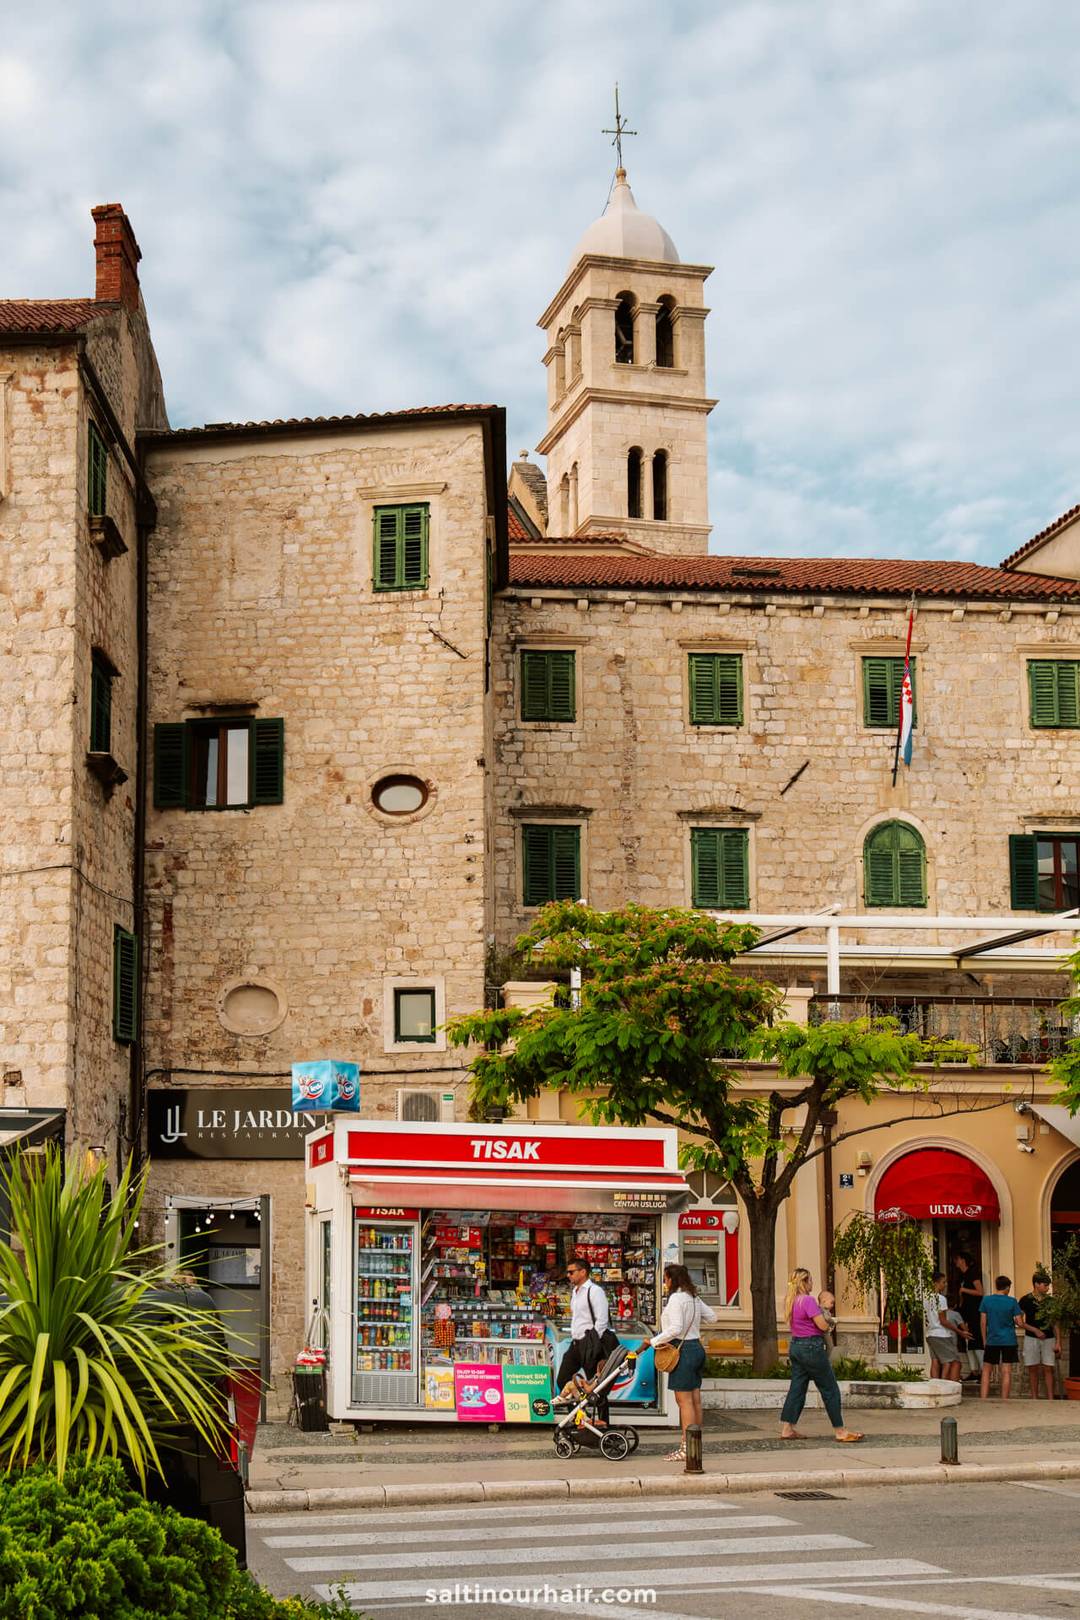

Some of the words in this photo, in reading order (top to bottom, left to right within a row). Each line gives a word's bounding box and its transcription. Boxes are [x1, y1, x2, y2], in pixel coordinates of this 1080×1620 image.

[197, 1110, 226, 1128] LE
[233, 1110, 317, 1132] JARDIN
[470, 1140, 541, 1160] TISAK
[614, 1200, 639, 1208] CENTAR
[640, 1201, 667, 1209] USLUGA
[929, 1204, 962, 1215] ULTRA
[681, 1216, 701, 1225] ATM
[507, 1401, 520, 1411] 30
